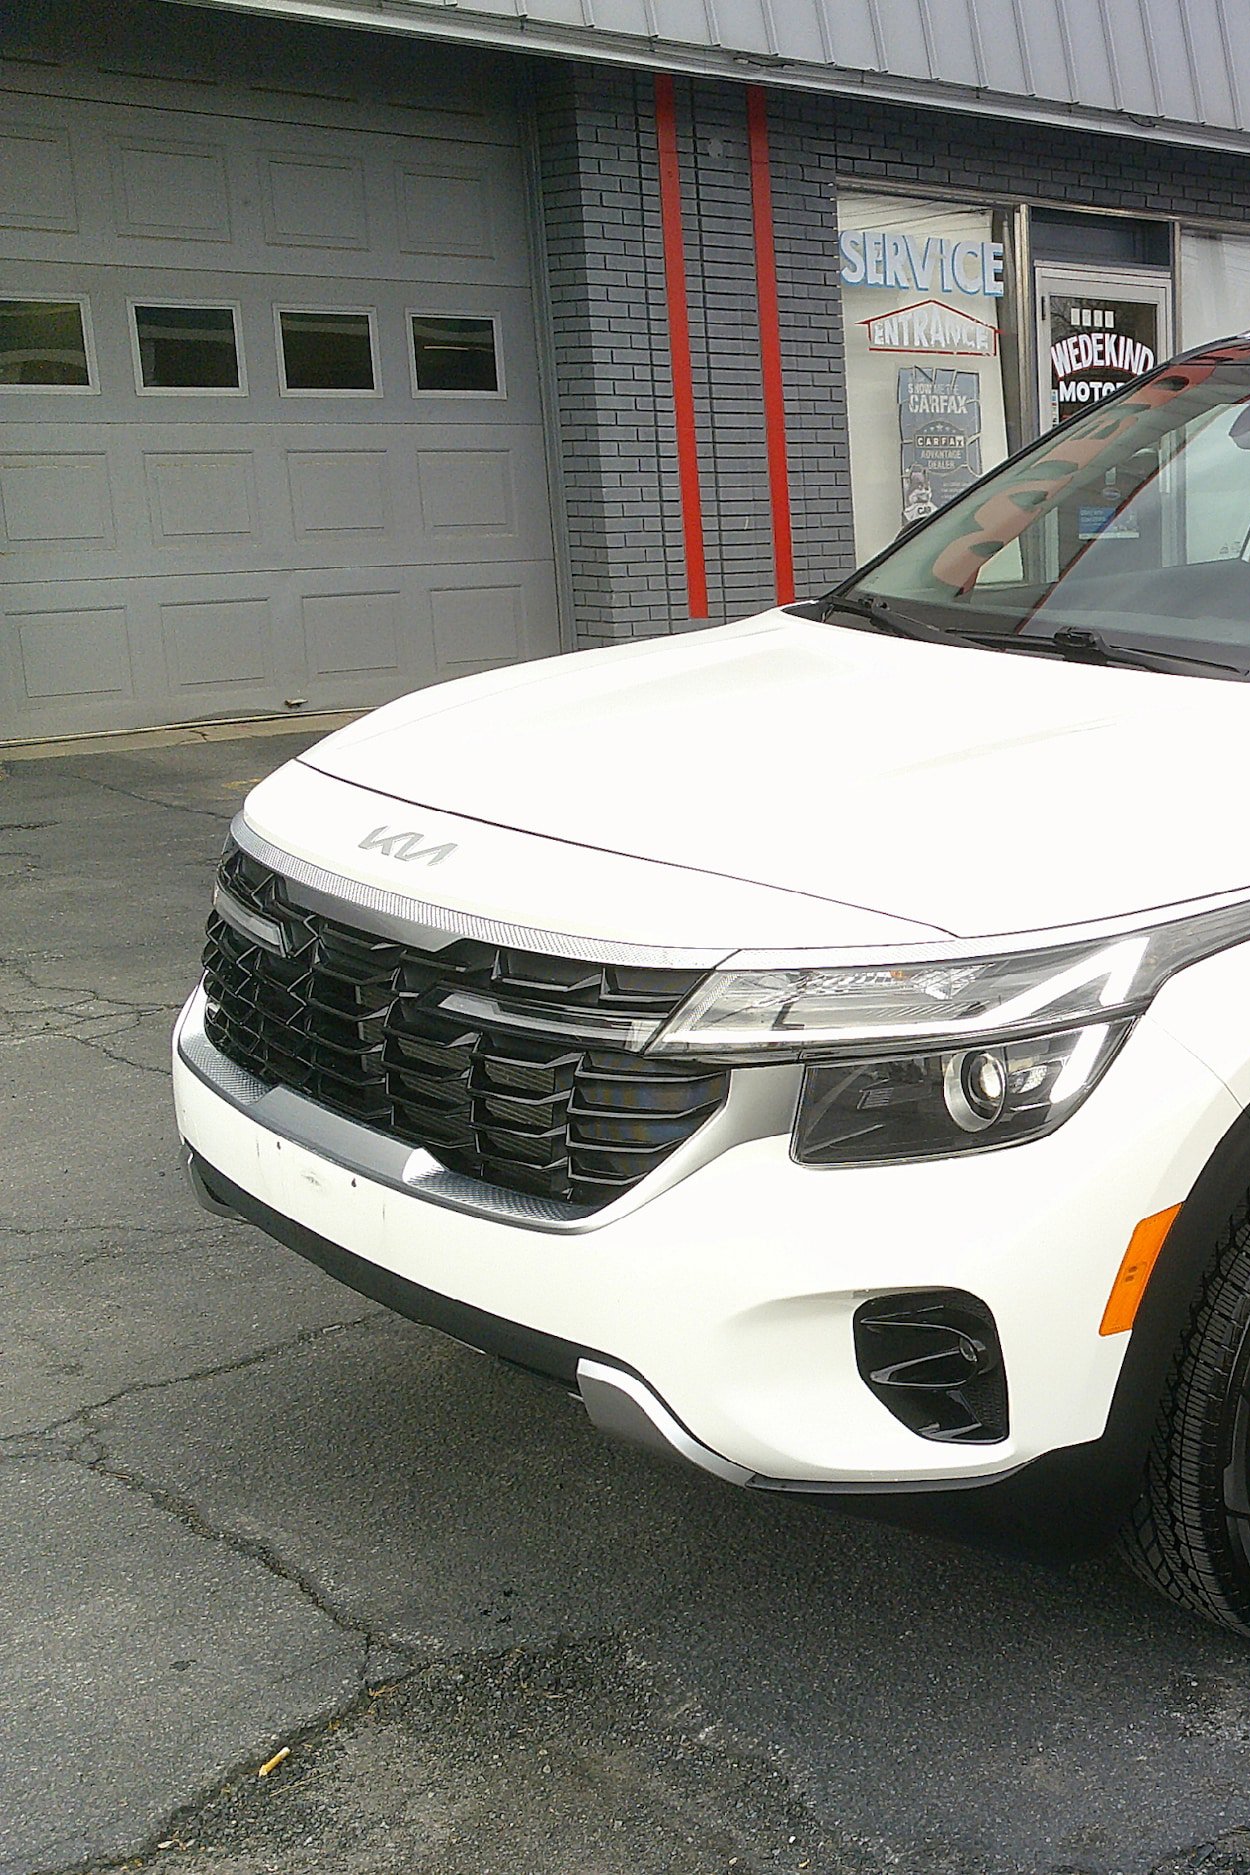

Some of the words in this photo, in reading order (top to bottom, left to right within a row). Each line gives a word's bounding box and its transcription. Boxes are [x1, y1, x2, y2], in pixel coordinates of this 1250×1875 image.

[839, 230, 1004, 297] SERVICE
[874, 306, 989, 350] ENTRANCE
[1051, 332, 1154, 378] WEDEKIND
[909, 394, 968, 414] CARFAX
[1059, 381, 1125, 402] MOTO
[917, 436, 964, 447] CARFAX
[358, 825, 458, 866] KIA
